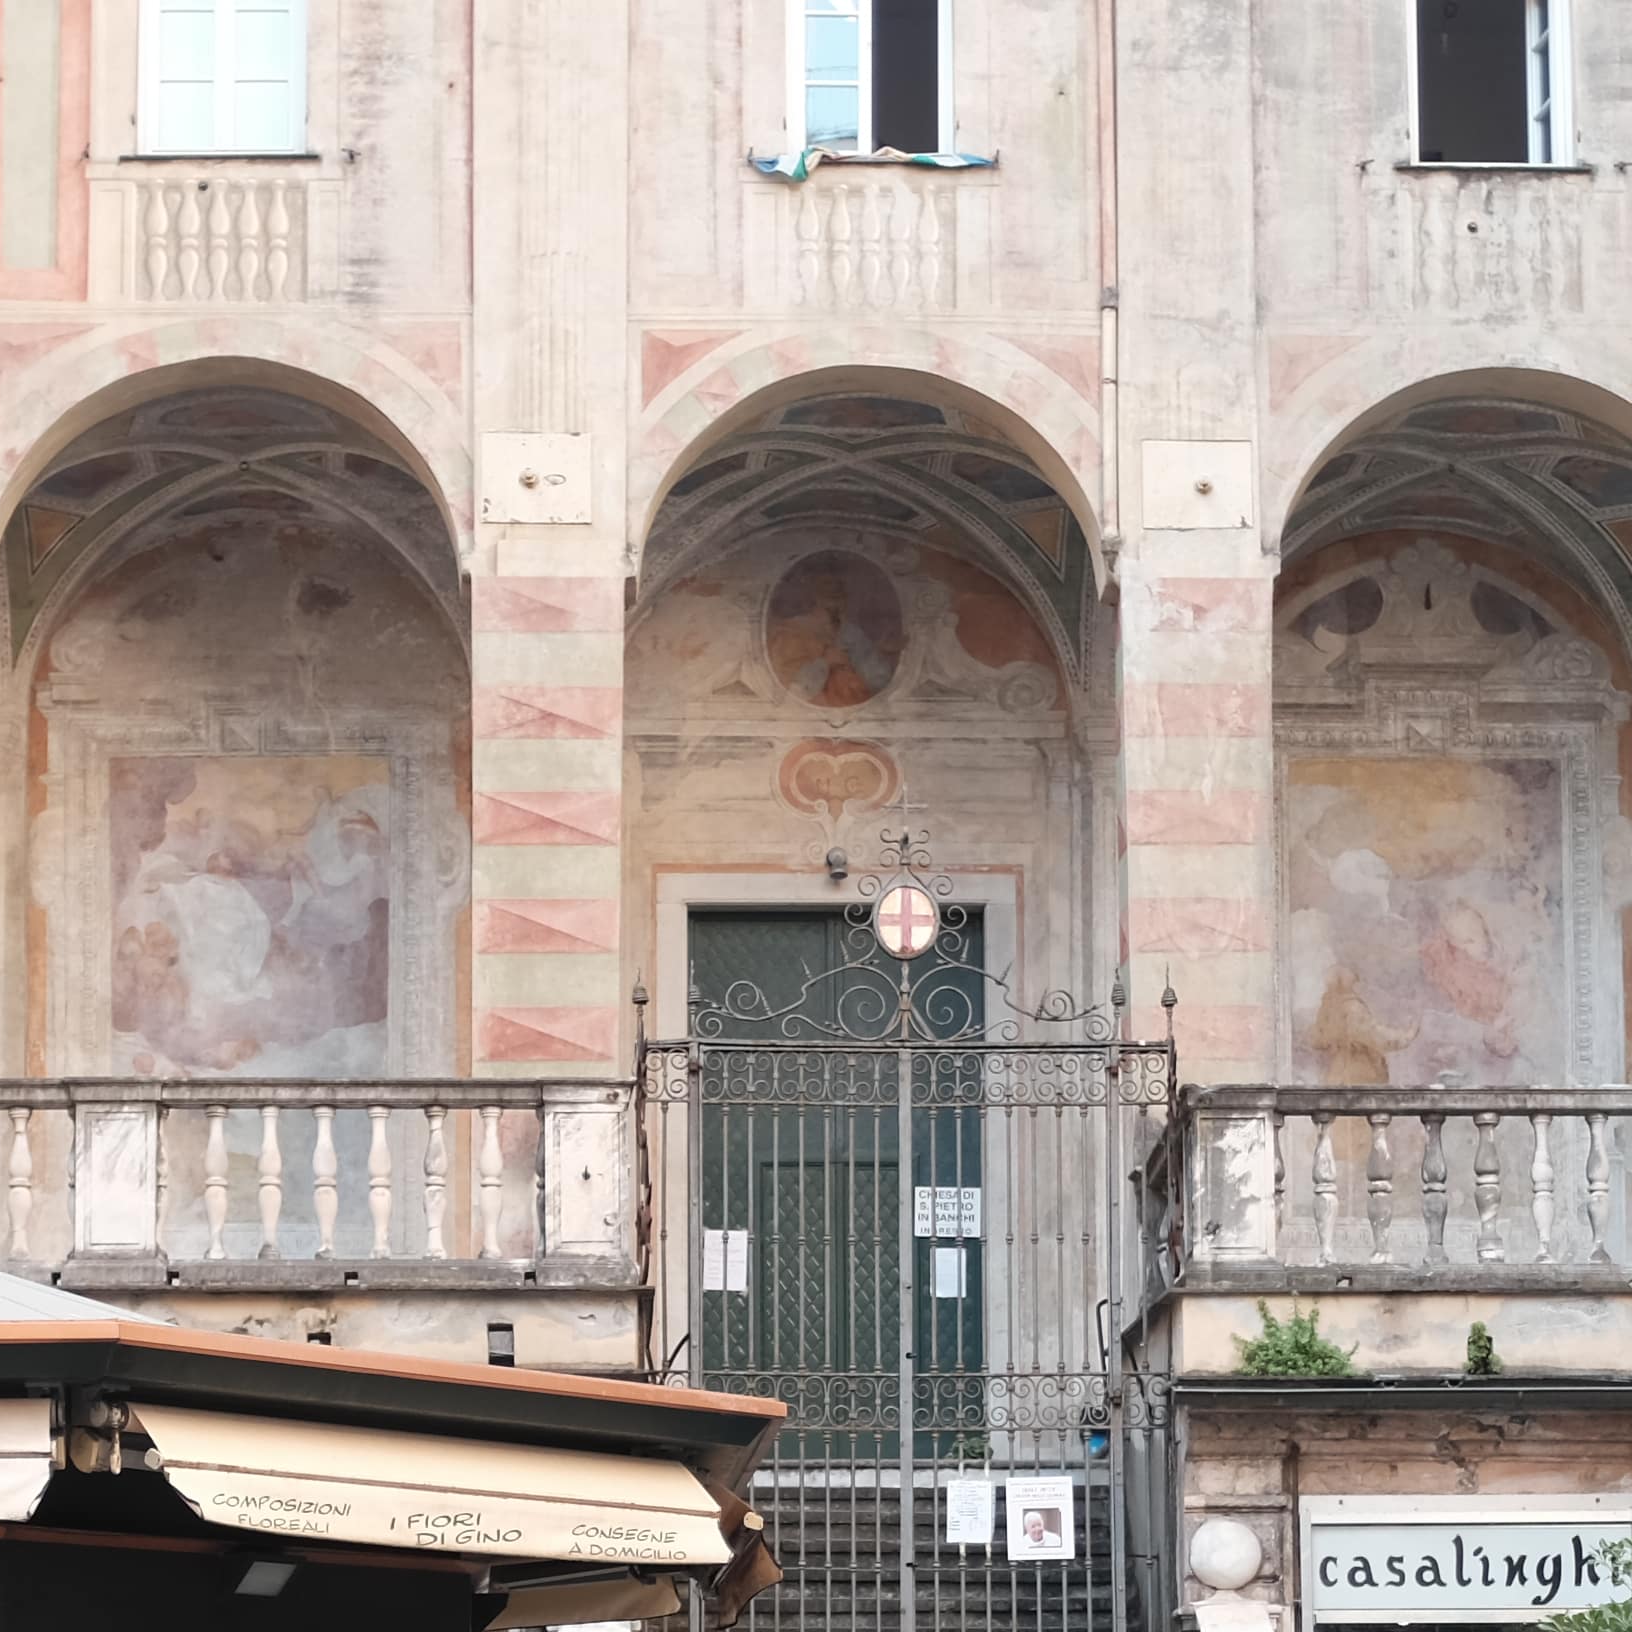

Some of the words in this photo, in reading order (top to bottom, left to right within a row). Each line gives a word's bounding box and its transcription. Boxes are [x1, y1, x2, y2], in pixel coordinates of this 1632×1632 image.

[963, 1191, 974, 1200] DI
[212, 1493, 352, 1517] COMPOSIZIONI
[237, 1513, 330, 1534] FLOREALI
[390, 1517, 396, 1531] I
[407, 1512, 481, 1529] FIORI
[416, 1532, 445, 1546] DI
[455, 1529, 522, 1545] GINO
[571, 1524, 678, 1543] CONSEGNE
[568, 1542, 582, 1554] A
[589, 1544, 687, 1560] DOMICILIO
